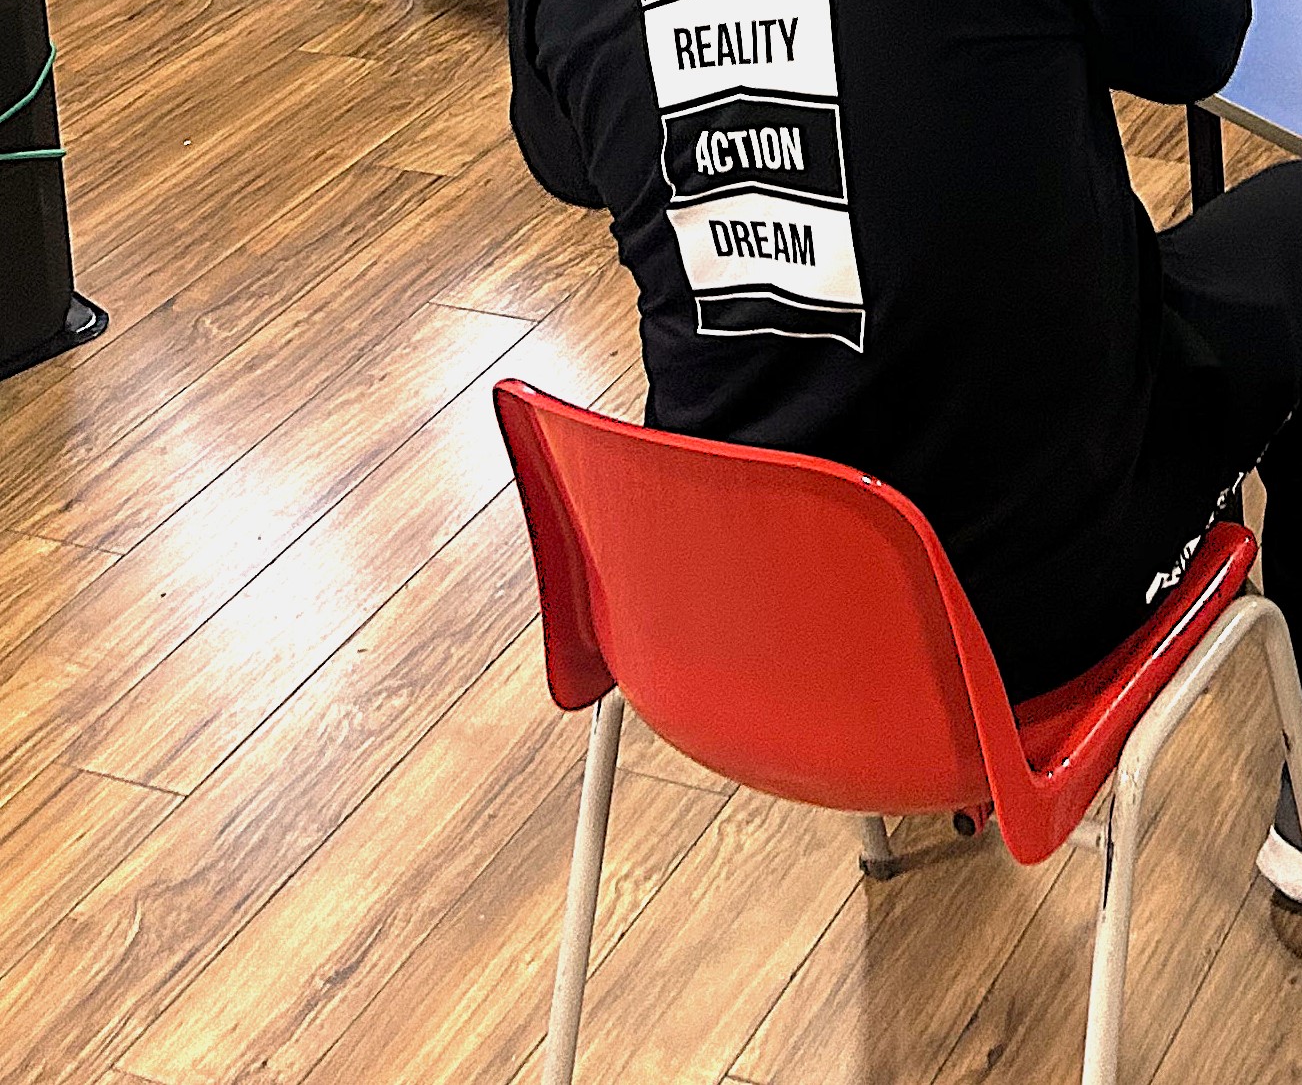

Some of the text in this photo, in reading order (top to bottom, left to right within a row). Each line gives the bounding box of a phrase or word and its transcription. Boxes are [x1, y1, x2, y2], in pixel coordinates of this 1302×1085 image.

[673, 16, 799, 70] REALITY
[695, 126, 805, 175] ACTION
[708, 219, 816, 267] DREAM
